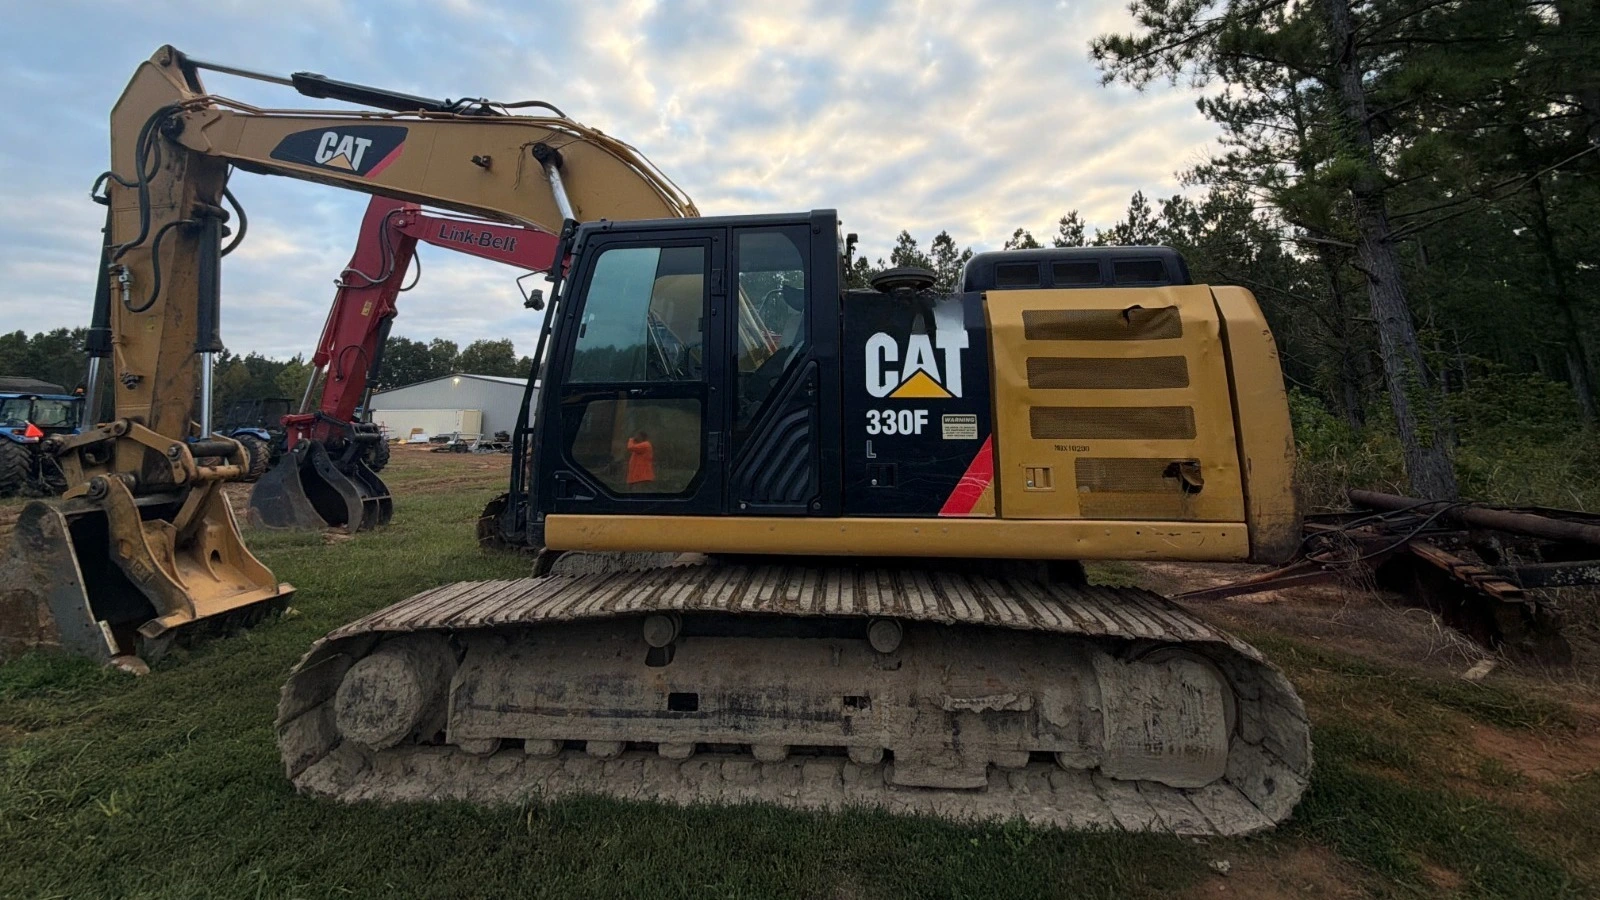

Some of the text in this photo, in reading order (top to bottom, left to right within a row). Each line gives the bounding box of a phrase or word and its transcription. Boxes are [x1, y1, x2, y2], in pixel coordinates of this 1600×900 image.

[315, 131, 372, 171] CAT
[438, 223, 516, 251] Link-Belt
[865, 331, 969, 398] CAT
[866, 409, 929, 435] 330F
